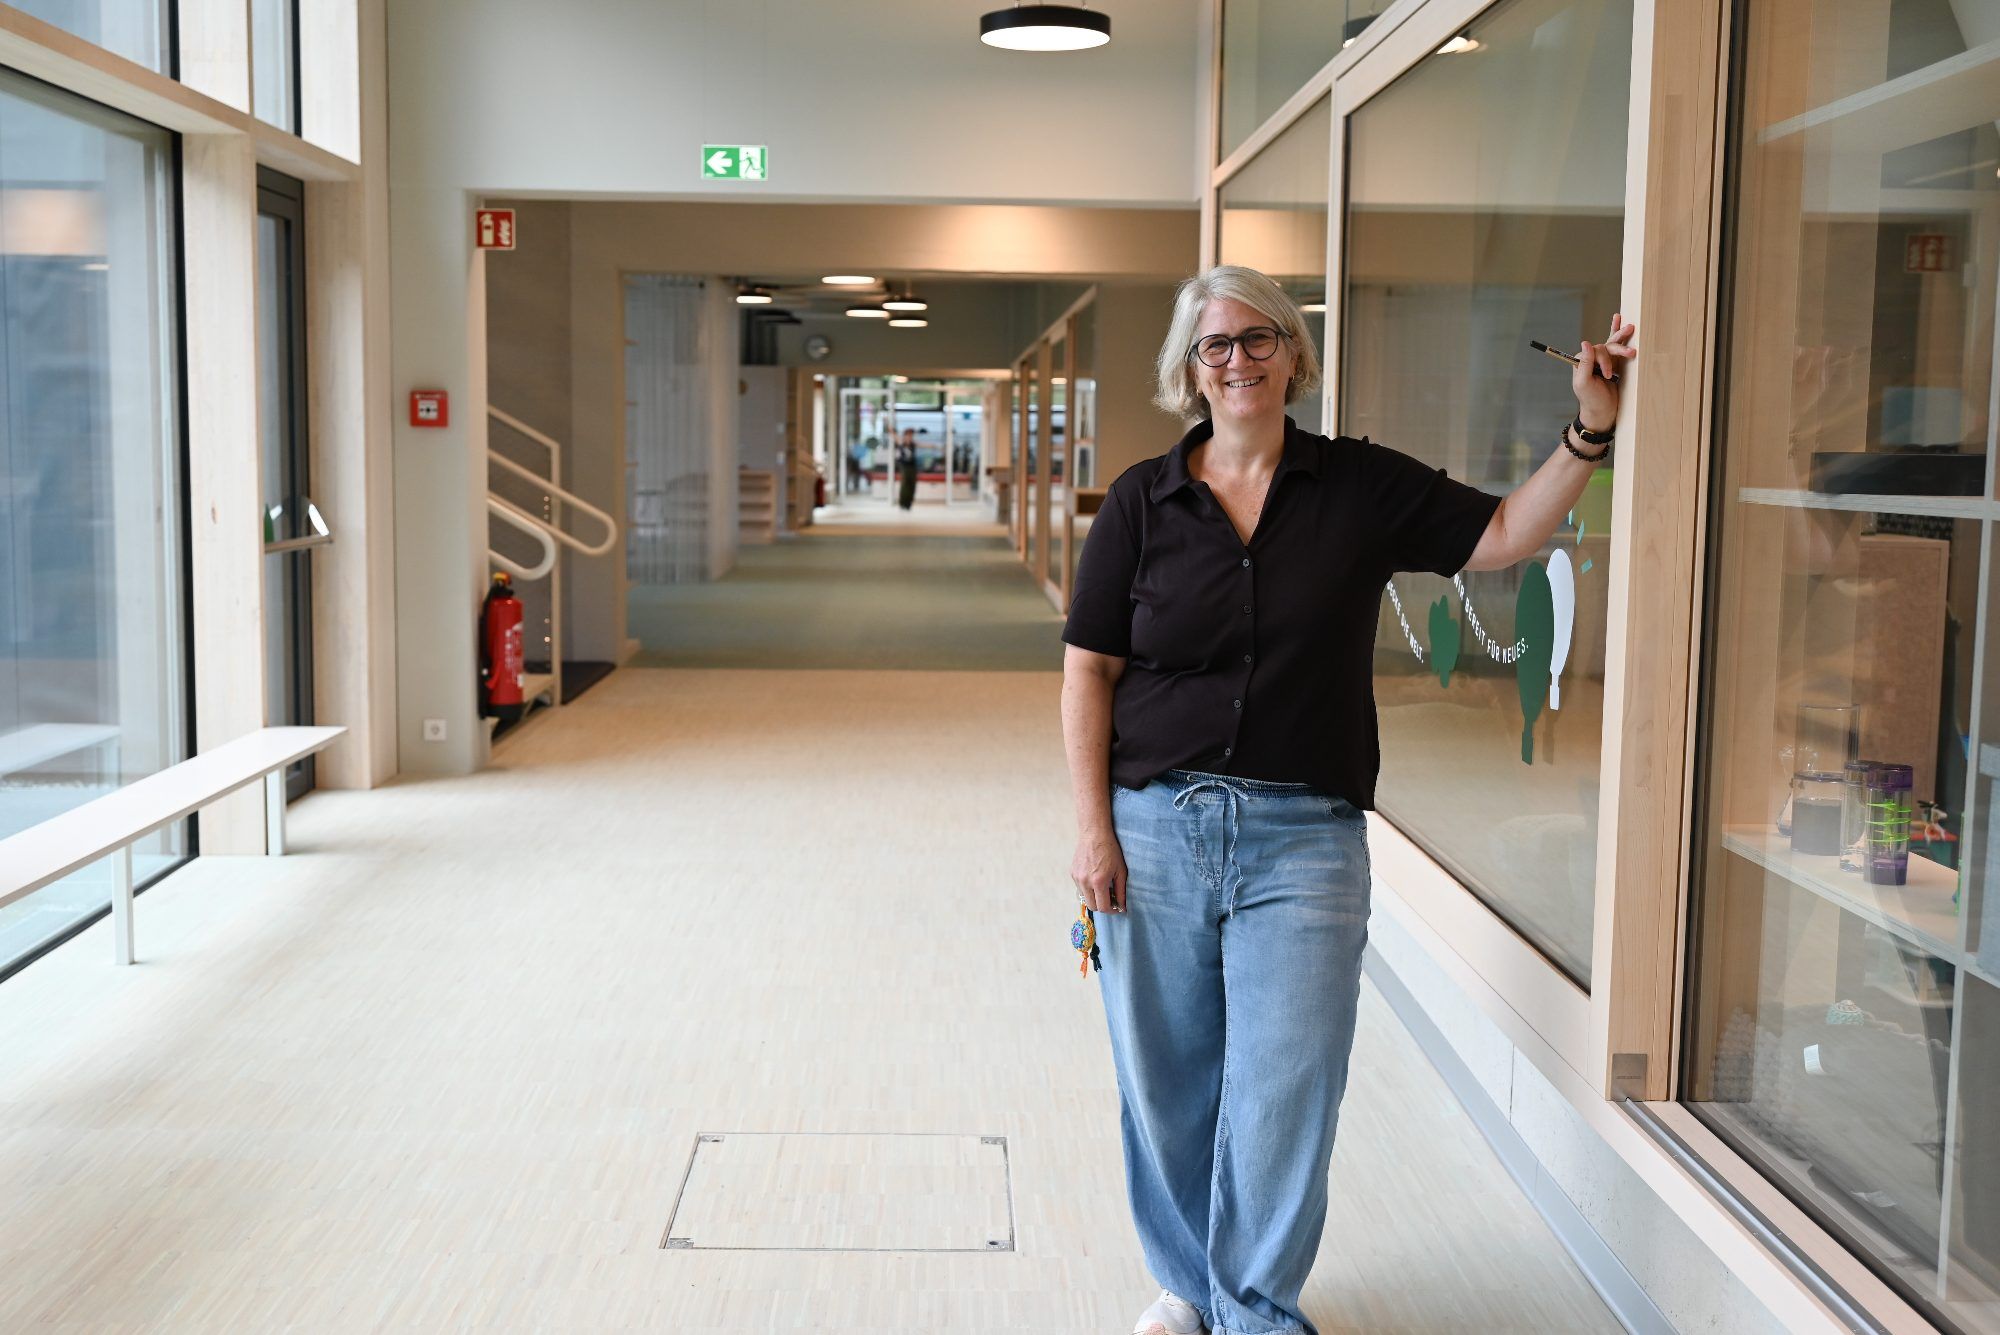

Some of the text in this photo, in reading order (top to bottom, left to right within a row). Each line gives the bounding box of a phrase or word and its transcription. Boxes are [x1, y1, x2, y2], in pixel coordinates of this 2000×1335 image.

[1401, 613, 1409, 638] DIE
[1410, 632, 1423, 664] WELT.
[1465, 597, 1485, 646] BEREIT
[1502, 638, 1528, 663] NEUES.
